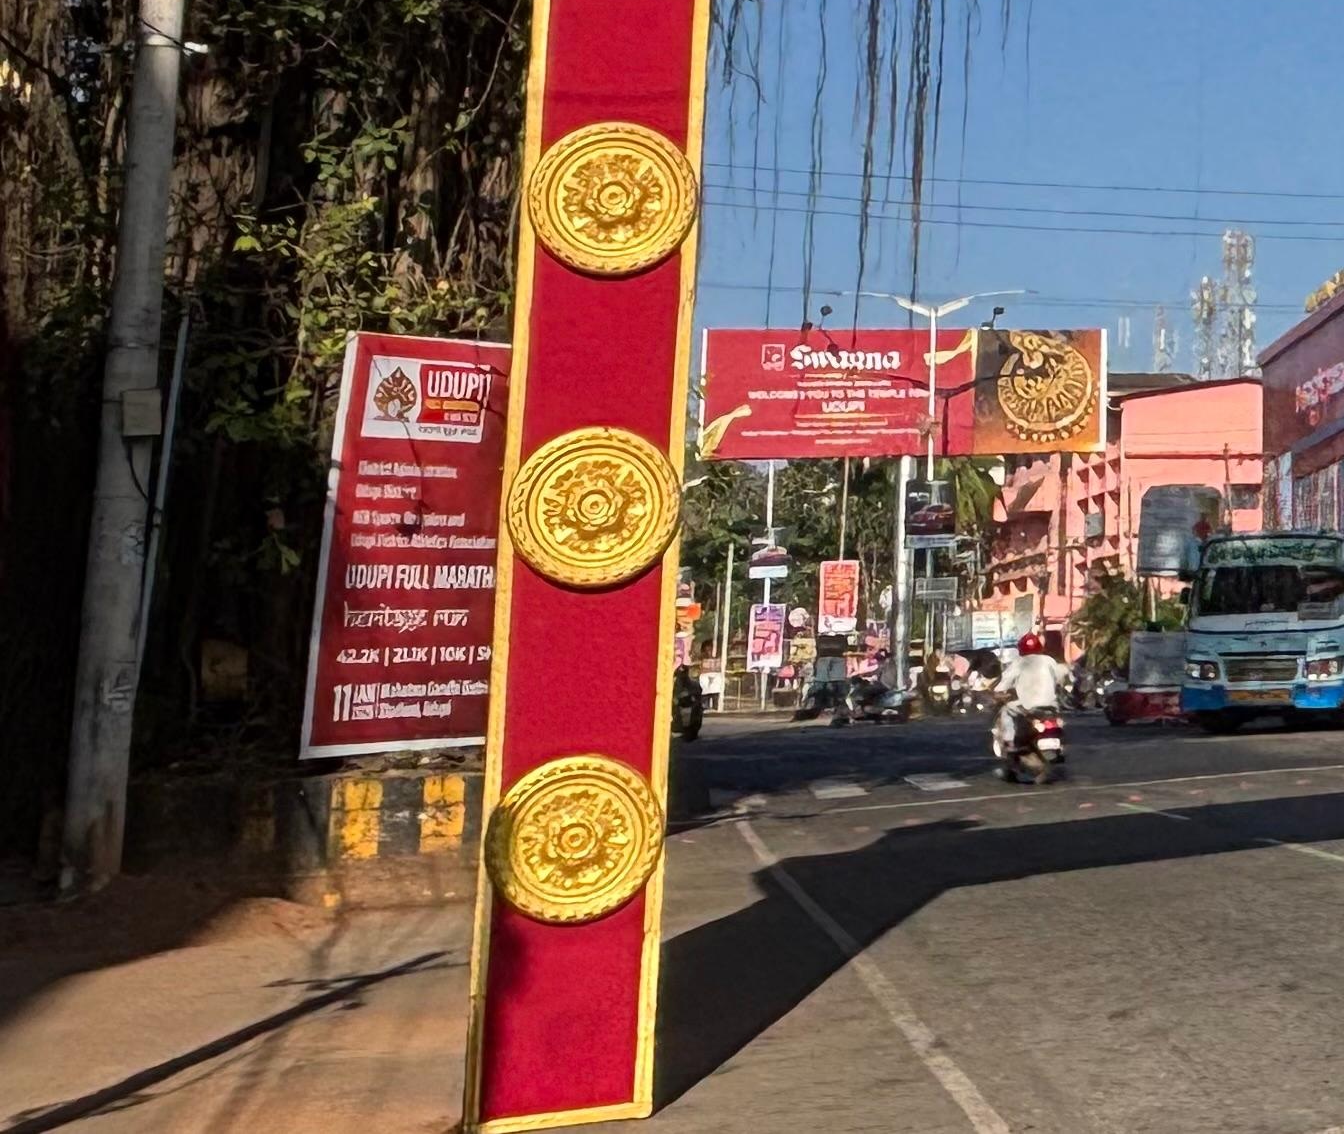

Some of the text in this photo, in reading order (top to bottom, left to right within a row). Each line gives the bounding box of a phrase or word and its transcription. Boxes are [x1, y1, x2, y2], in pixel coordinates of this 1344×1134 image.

[345, 563, 495, 590] UDUPI FULL MARATH
[344, 601, 470, 634] heritage run
[439, 646, 467, 663] 10K
